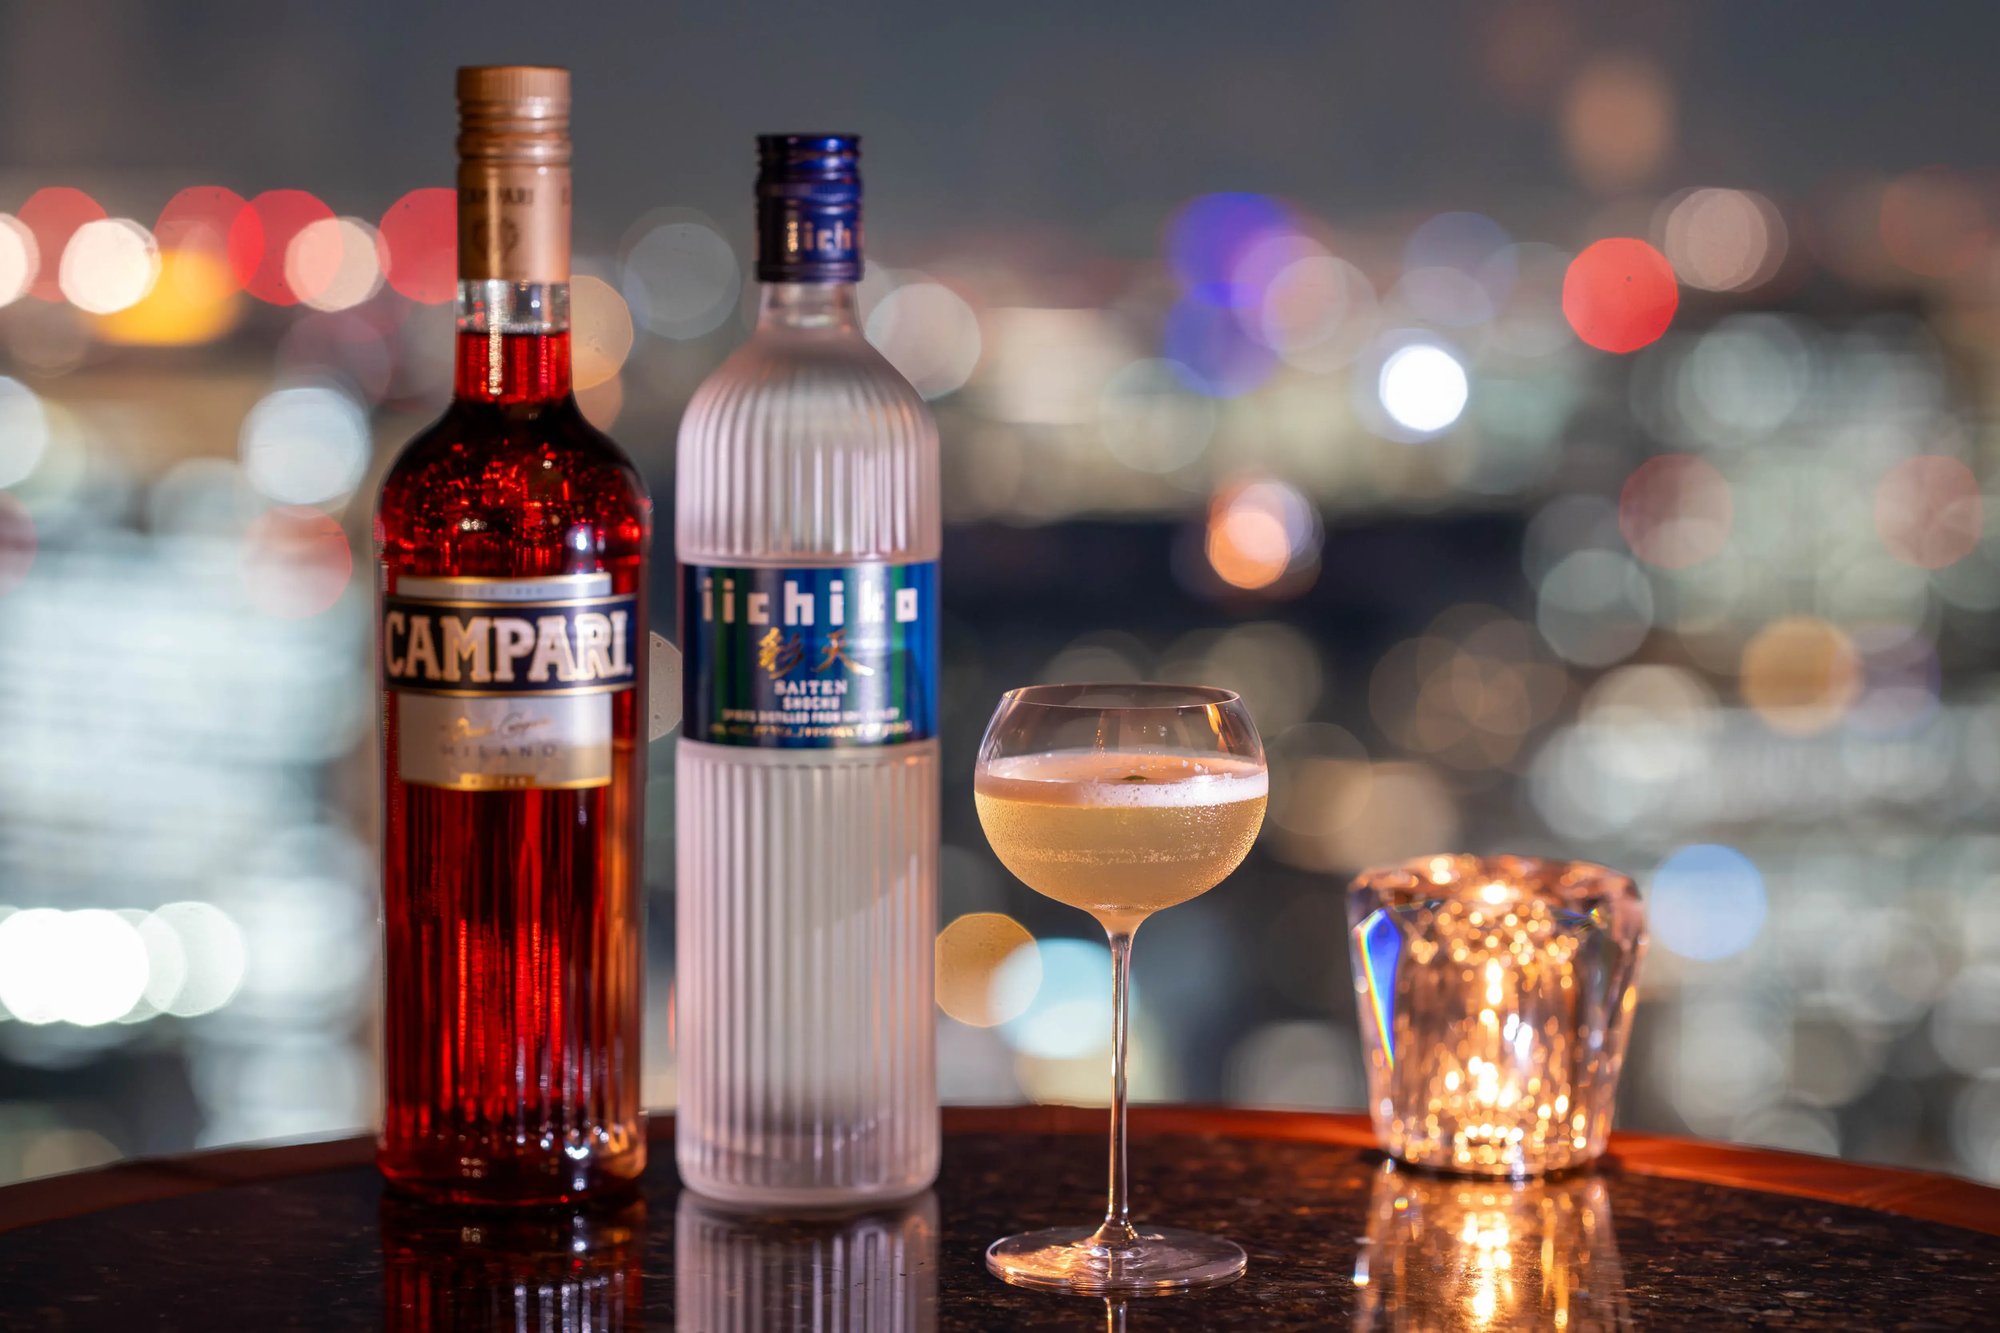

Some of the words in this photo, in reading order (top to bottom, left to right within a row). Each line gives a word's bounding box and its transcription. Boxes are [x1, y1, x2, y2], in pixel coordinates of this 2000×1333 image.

[702, 577, 919, 627] iichiko
[384, 610, 631, 683] CAMPARI
[773, 680, 848, 696] SAITEN
